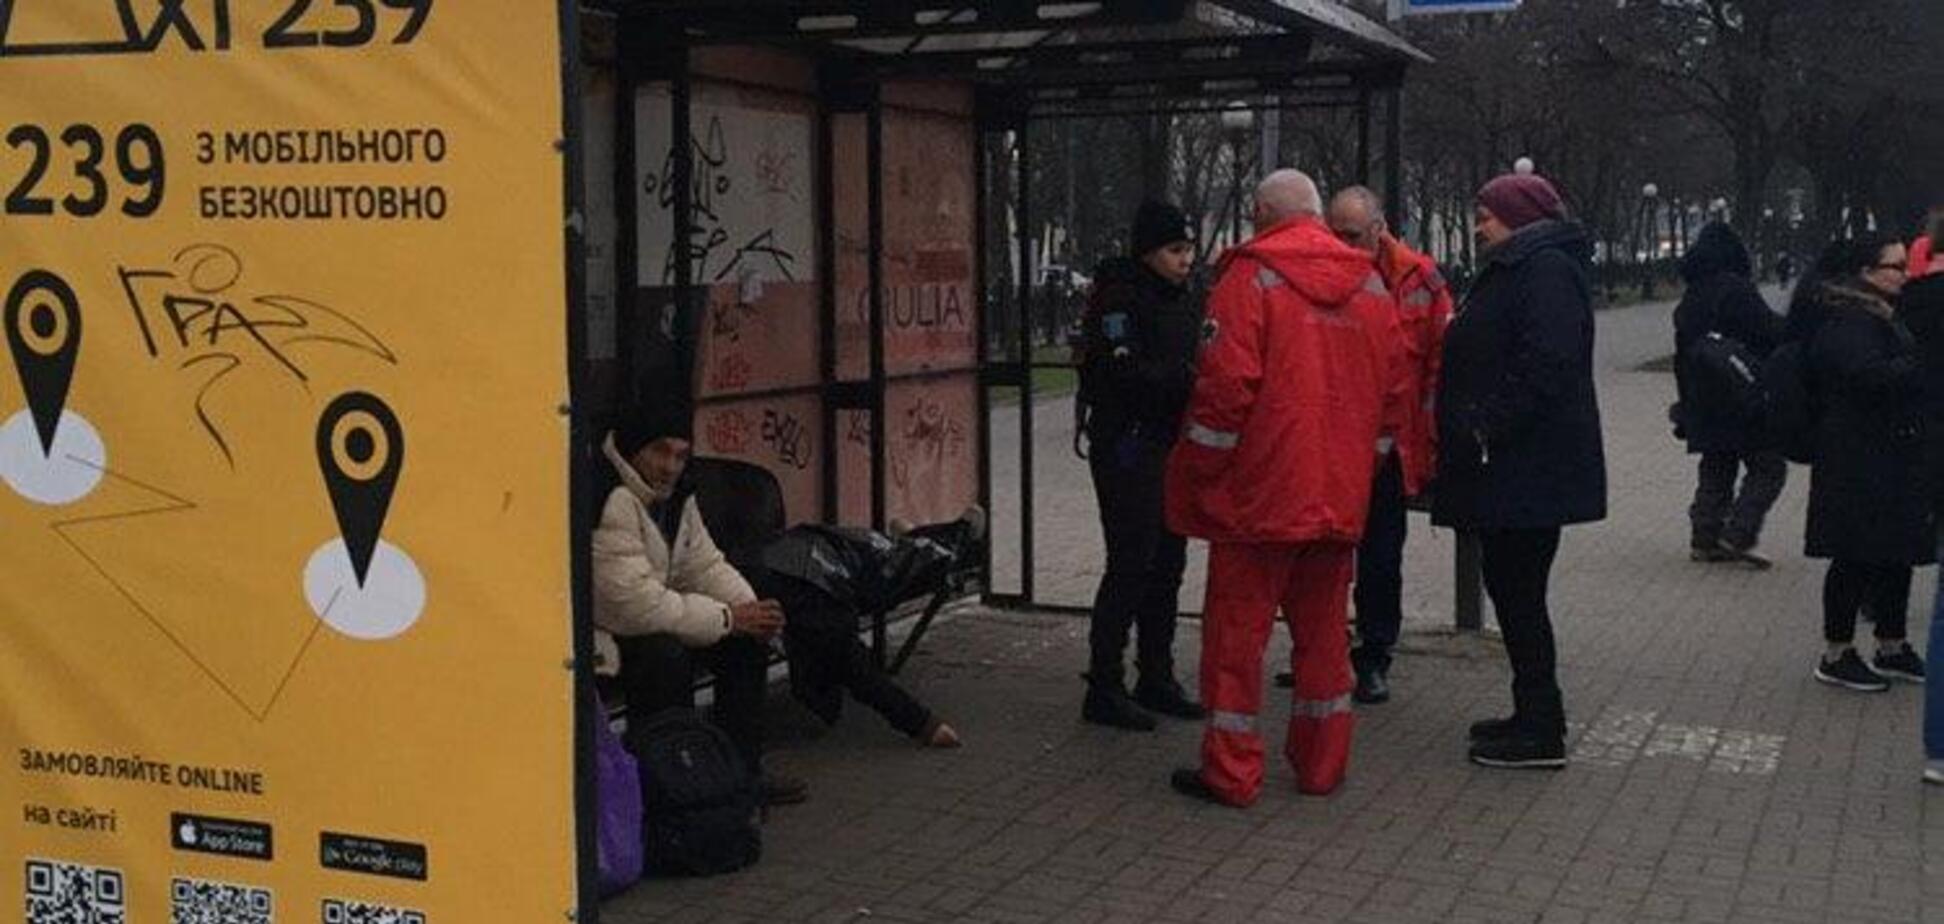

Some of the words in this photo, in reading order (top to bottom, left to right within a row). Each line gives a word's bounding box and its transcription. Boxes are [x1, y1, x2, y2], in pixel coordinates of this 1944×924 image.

[224, 128, 446, 164] МОБІЛЬНОГО
[5, 123, 166, 218] 239
[199, 185, 447, 220] БЕЗКОШТОВНО
[20, 748, 171, 785] ЗАМОВЛЯЙТЕ
[177, 764, 263, 795] ONLINE
[24, 804, 50, 824] на
[56, 806, 116, 832] сайті
[202, 831, 229, 850] App
